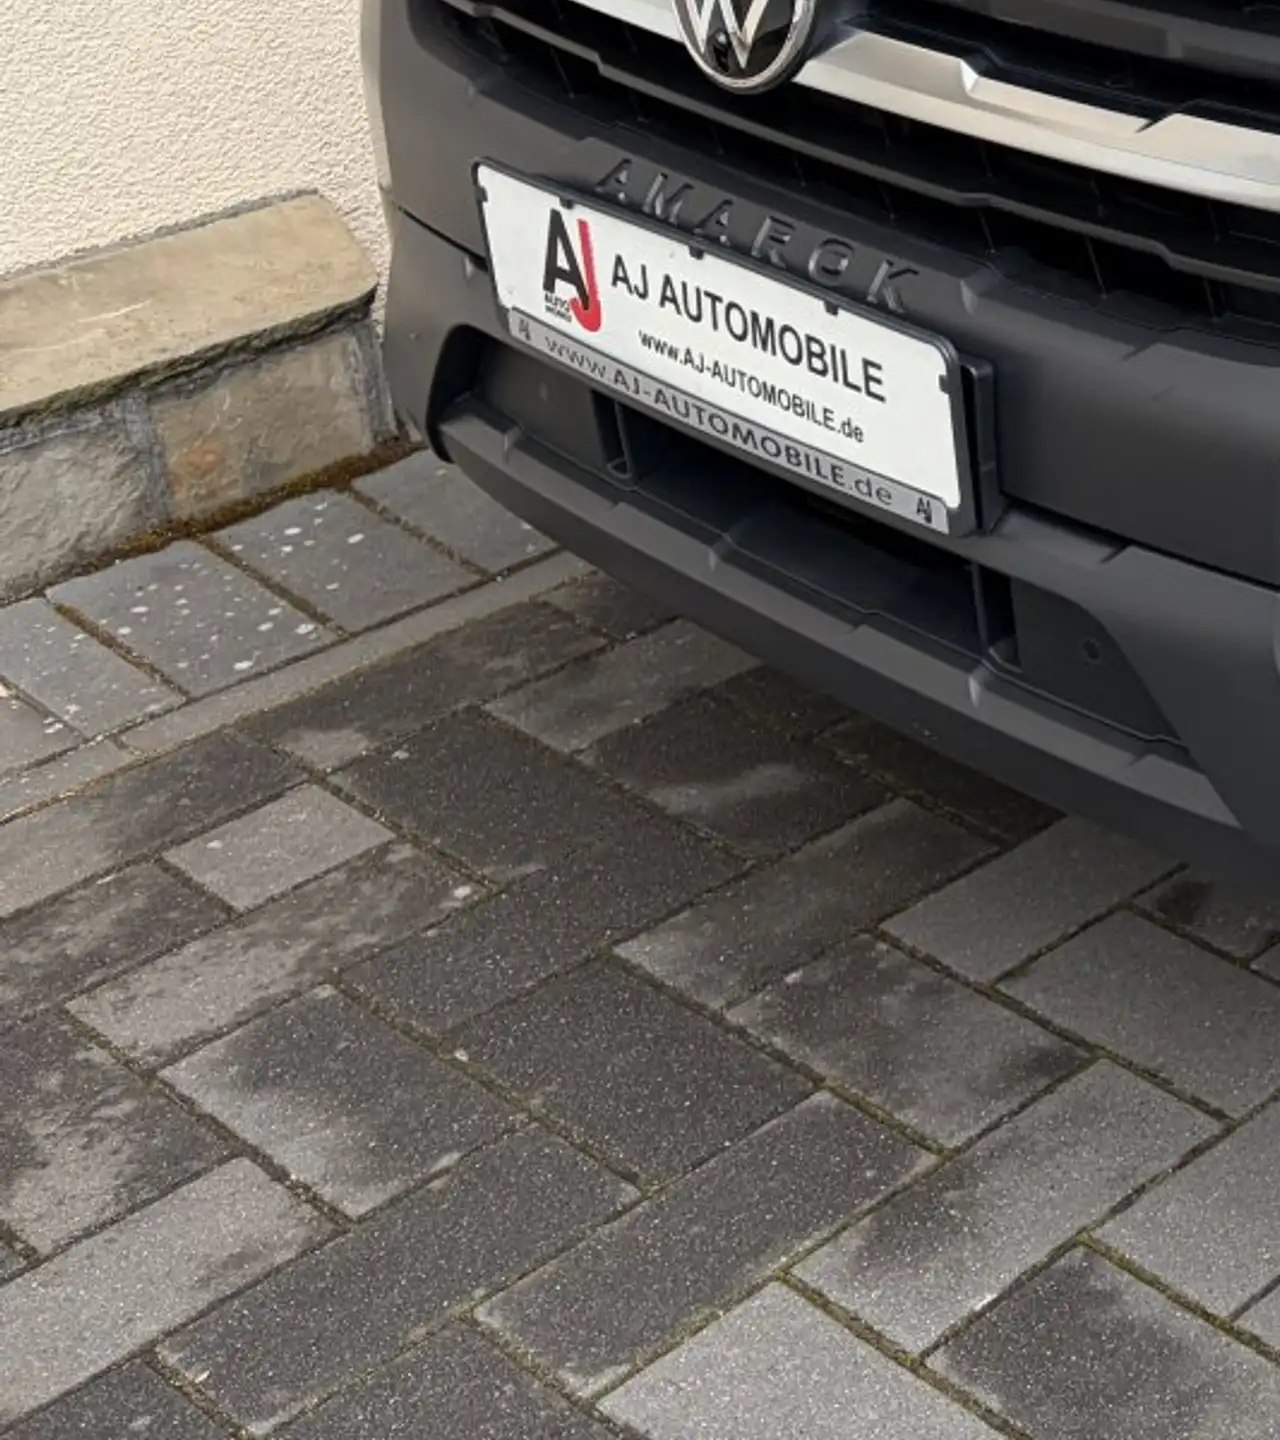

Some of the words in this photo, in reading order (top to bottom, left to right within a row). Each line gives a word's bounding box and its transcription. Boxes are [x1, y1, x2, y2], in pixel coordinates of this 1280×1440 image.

[543, 208, 601, 333] AJ
[595, 158, 919, 314] AMAROK
[611, 253, 649, 301] AJ
[659, 273, 887, 404] AUTOMOBILE
[638, 329, 864, 444] www.AJ-AUTOMOBILE.de
[544, 335, 893, 506] www.AJ-AUTOMOBILE.de
